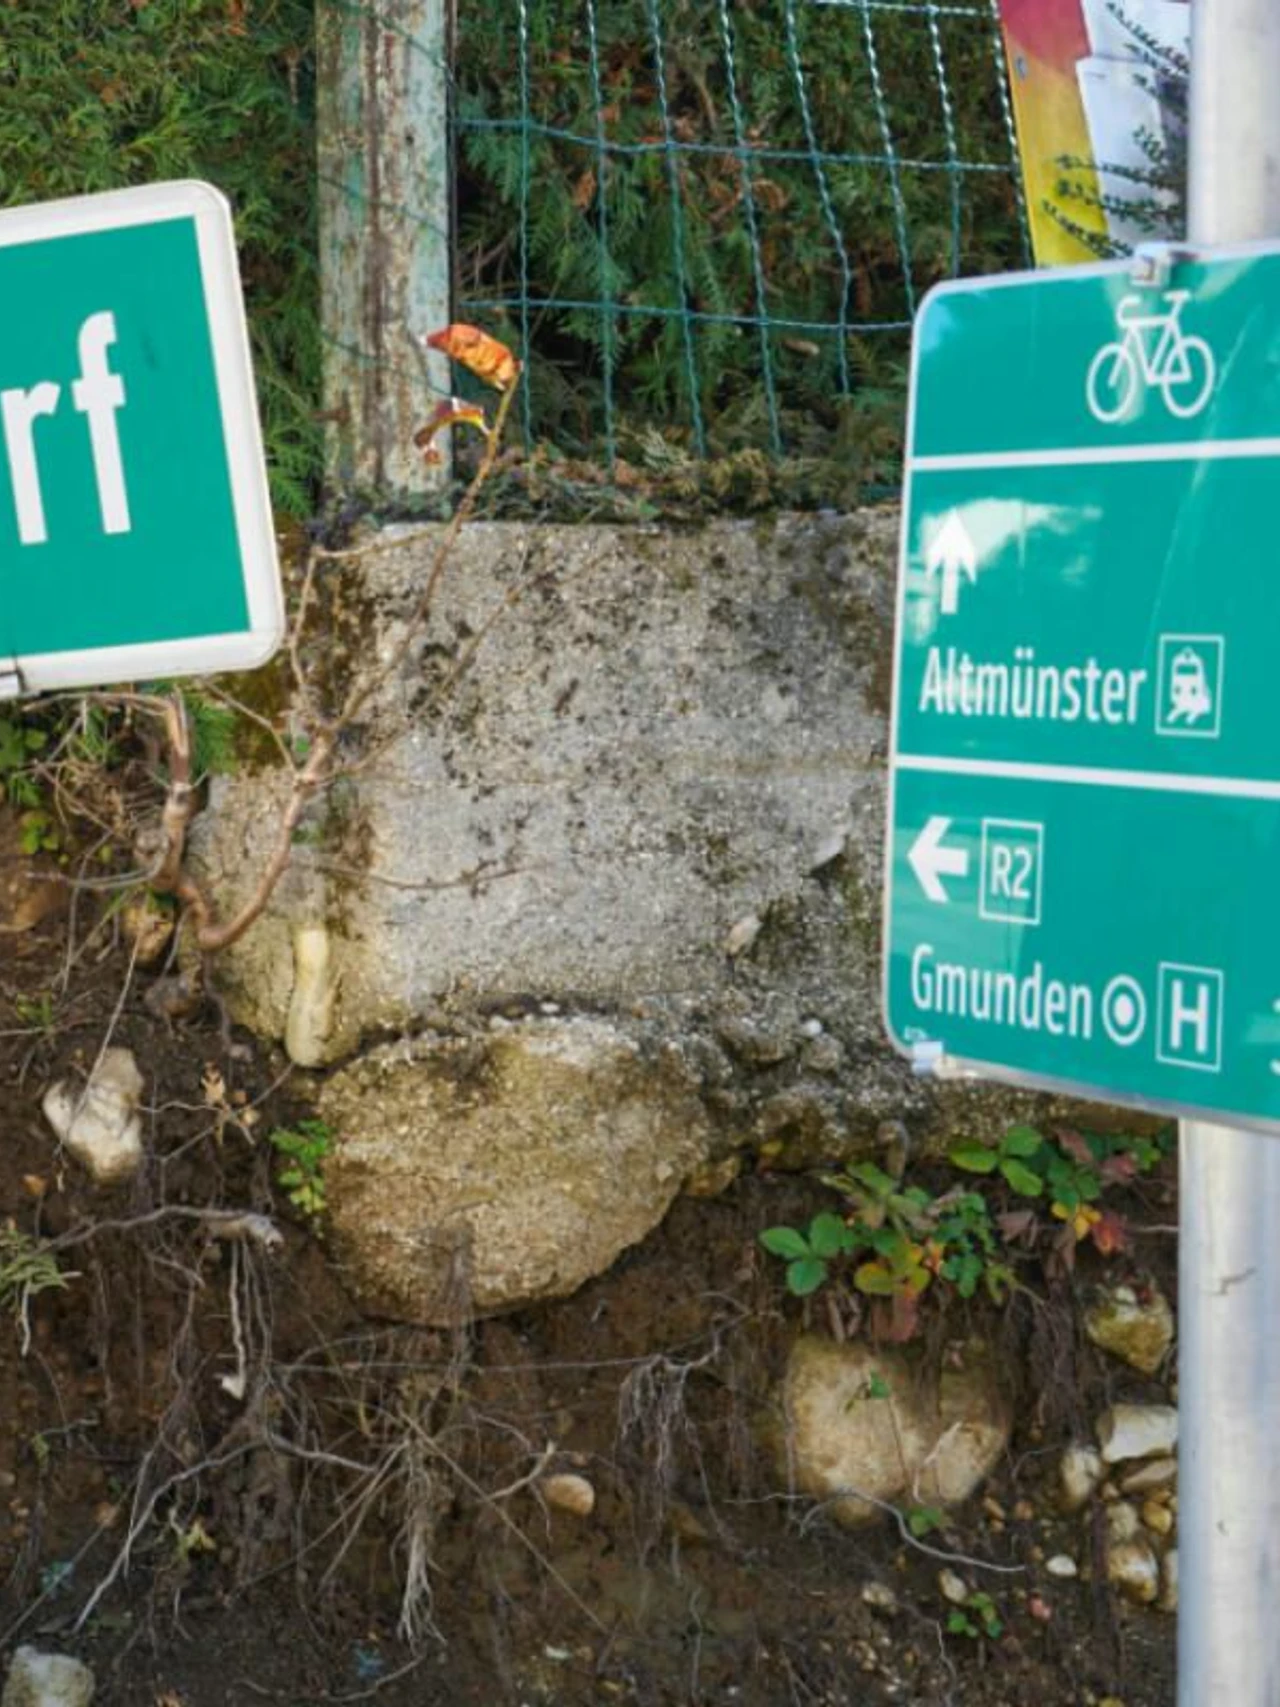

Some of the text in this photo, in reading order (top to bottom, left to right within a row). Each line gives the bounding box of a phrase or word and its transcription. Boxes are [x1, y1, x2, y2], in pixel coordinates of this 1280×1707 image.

[919, 647, 1147, 724] Altmünster
[990, 844, 1035, 901] R2
[911, 943, 1094, 1040] Gmunden
[1170, 979, 1210, 1055] H
